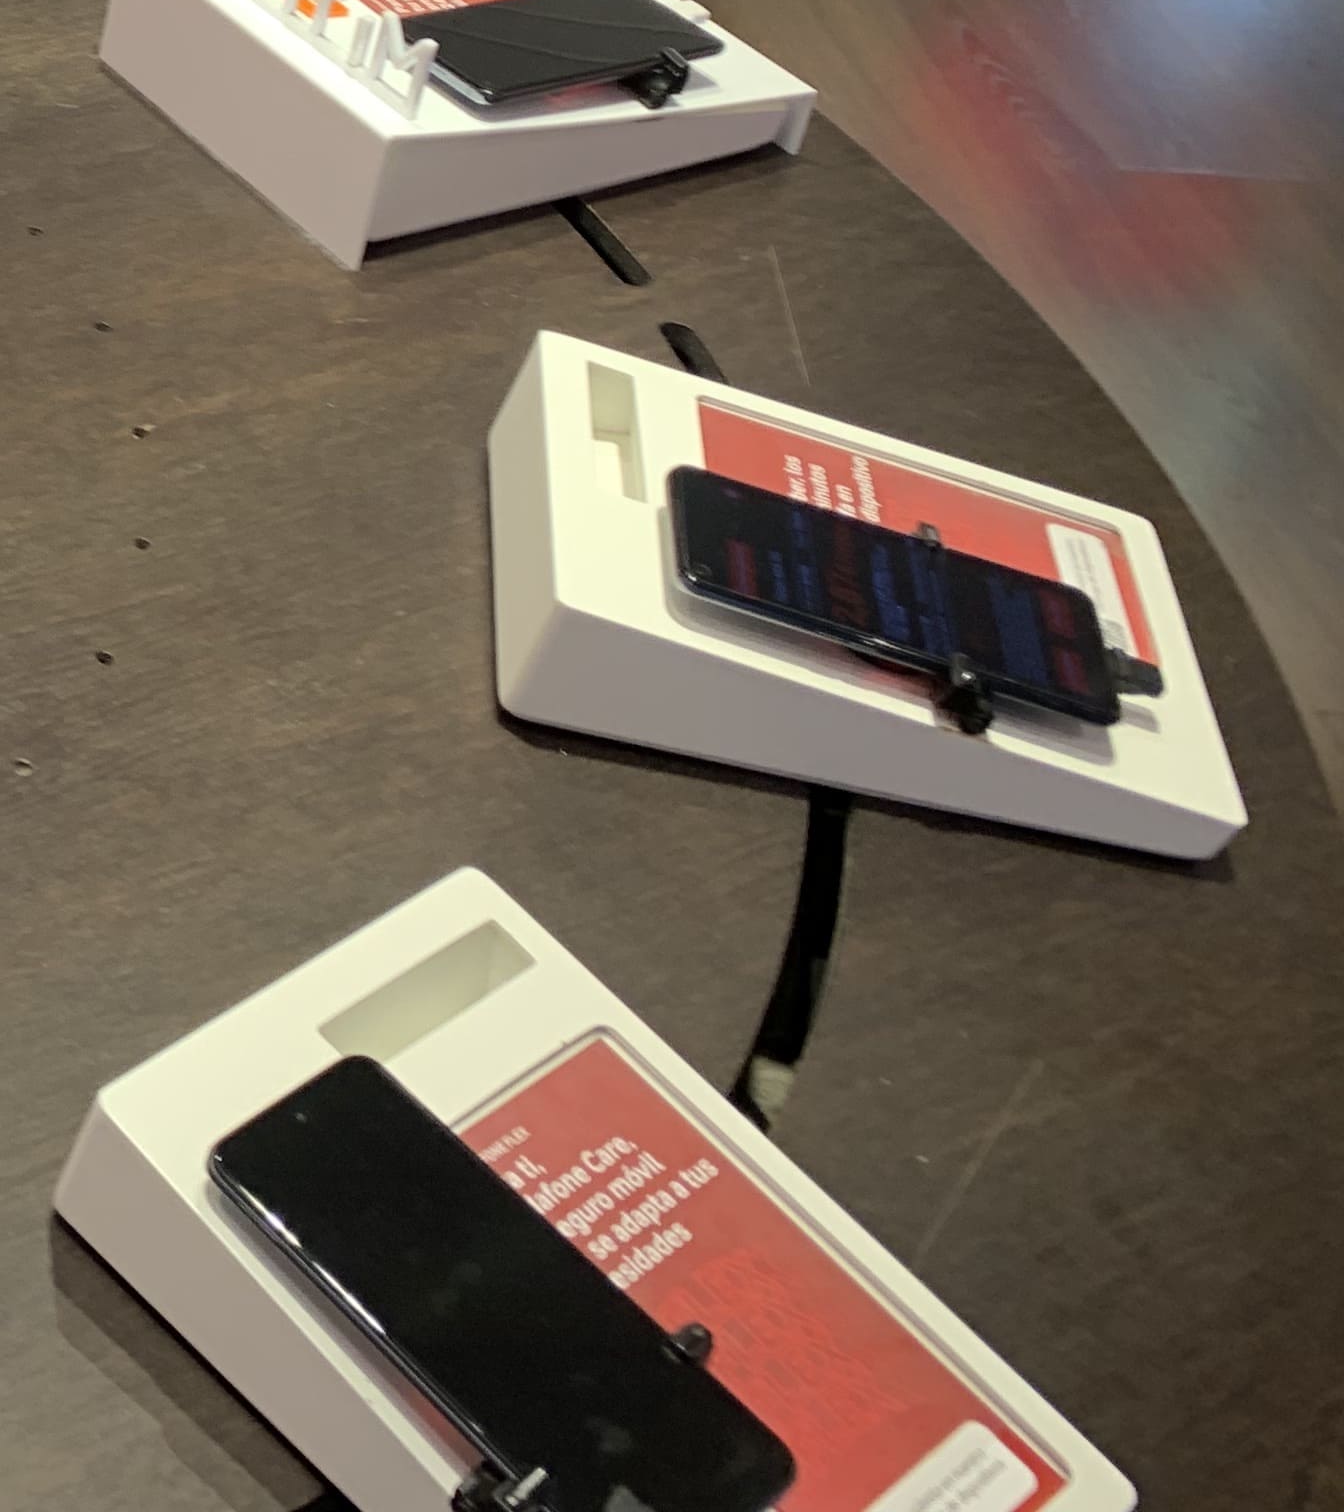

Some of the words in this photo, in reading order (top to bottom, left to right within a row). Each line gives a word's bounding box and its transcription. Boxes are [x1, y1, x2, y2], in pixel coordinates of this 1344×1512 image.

[783, 454, 804, 475] los
[808, 463, 833, 510] inutos
[851, 455, 882, 523] dispositivo
[580, 1136, 639, 1174] Care,
[678, 1158, 720, 1189] tus
[555, 1192, 615, 1239] eguro
[608, 1151, 667, 1200] móvil
[668, 1180, 691, 1199] a
[612, 1190, 678, 1244] adapta
[588, 1234, 618, 1261] se
[608, 1222, 694, 1290] esidades
